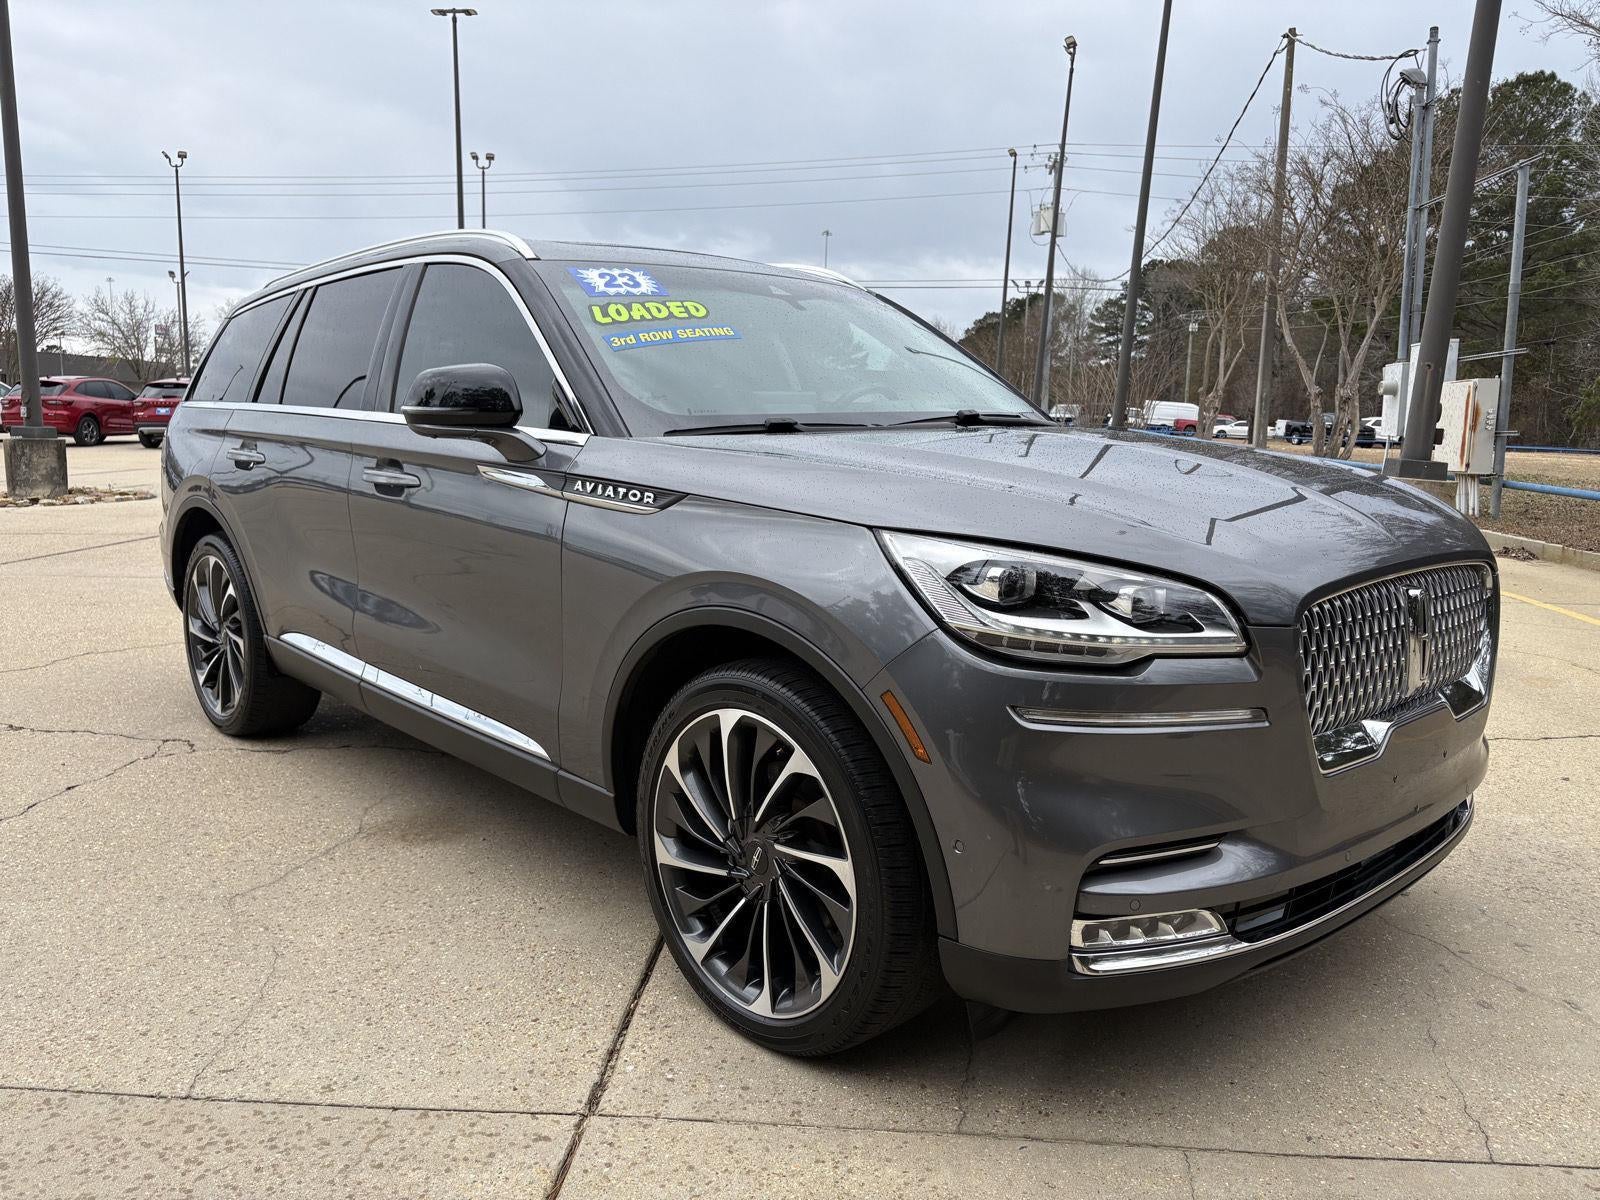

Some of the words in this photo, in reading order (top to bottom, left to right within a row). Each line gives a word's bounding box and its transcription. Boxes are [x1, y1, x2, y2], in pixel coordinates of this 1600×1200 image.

[598, 272, 642, 289] 23
[591, 301, 708, 324] LOADED
[610, 335, 636, 347] 3rd
[639, 330, 673, 343] ROW
[676, 326, 735, 339] SEATING
[573, 480, 655, 504] AVIATOR
